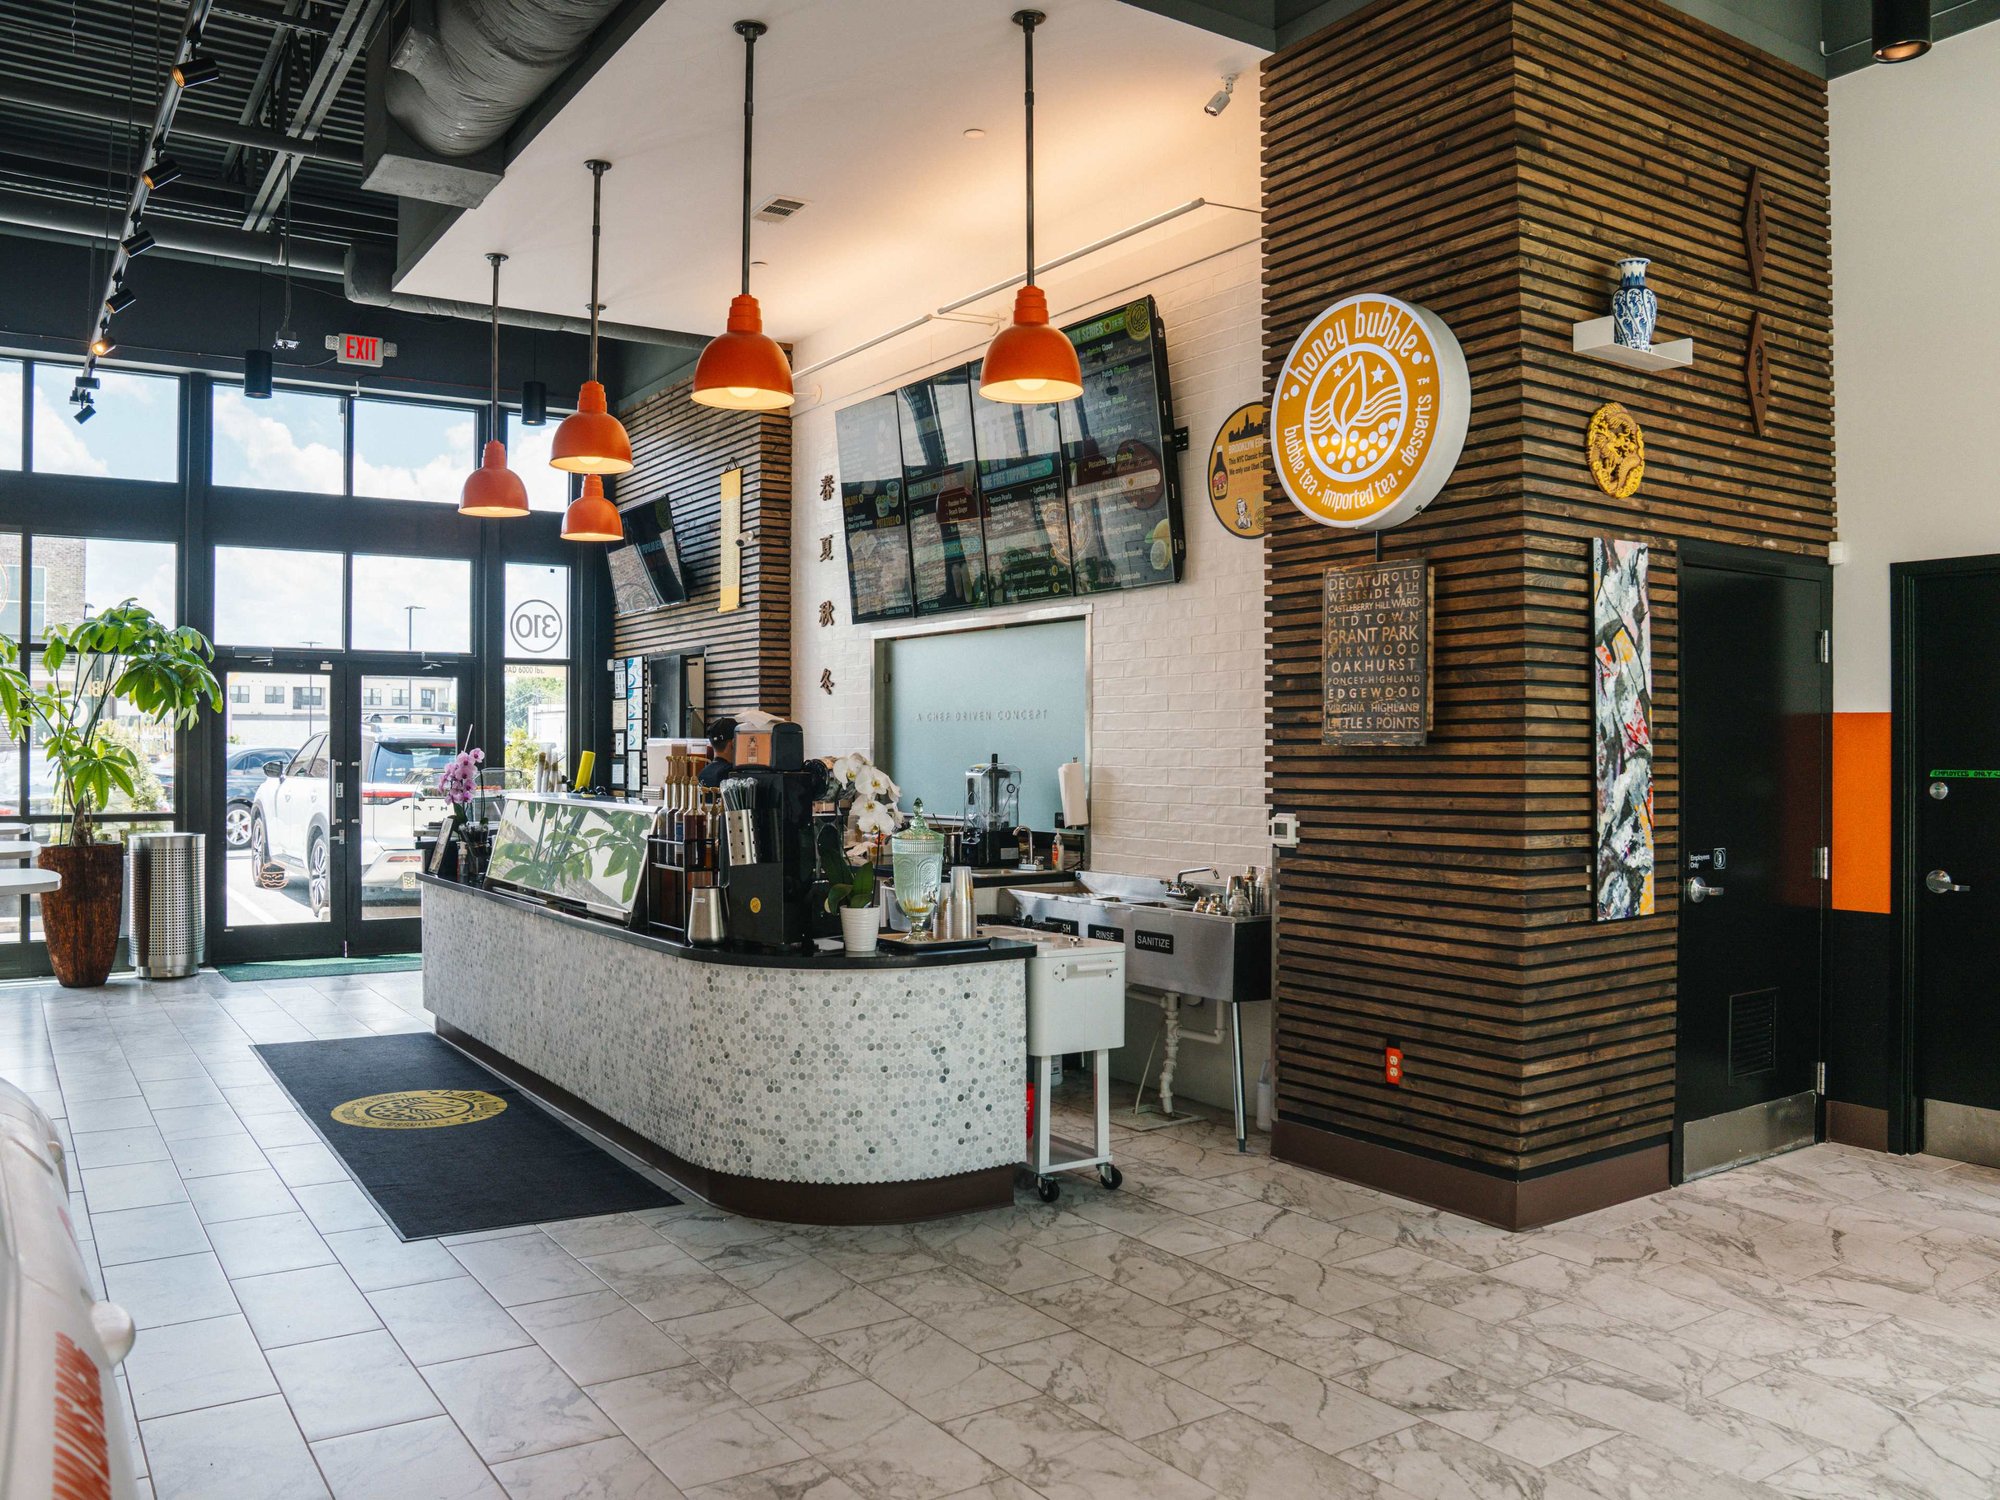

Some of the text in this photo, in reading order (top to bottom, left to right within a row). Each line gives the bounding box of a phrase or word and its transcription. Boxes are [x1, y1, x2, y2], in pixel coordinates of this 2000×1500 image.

[346, 335, 378, 361] EXIT
[1288, 303, 1418, 386] honey bubble
[1401, 394, 1432, 467] desserts
[1285, 424, 1318, 495] bubble tea
[1322, 473, 1398, 513] imported tea
[1329, 573, 1390, 591] DECATUR
[1392, 569, 1420, 582] OLD
[1328, 587, 1390, 602] WESTSIDE
[1395, 582, 1419, 598] 4TH
[1328, 601, 1391, 613] CASTLEBERRY HILL
[1391, 597, 1420, 608] WARD
[1328, 625, 1419, 645] GRANT PARK
[1328, 643, 1420, 659] KIRKWOOD
[1331, 657, 1416, 673] OAKHURST
[1327, 675, 1420, 686] PONCEY-HIGHLAND
[1328, 687, 1420, 699] EDGEWOOD
[927, 712, 950, 721] CHEF
[955, 711, 992, 721] DRIVEN
[998, 709, 1047, 720] CONCEPT
[1327, 702, 1420, 714] VIRGINIA HIGHLAND
[1327, 716, 1420, 730] LITTLE 5 POINTS
[1691, 861, 1699, 869] Only
[1095, 930, 1115, 941] RINSE
[1137, 935, 1170, 949] SANITIZE
